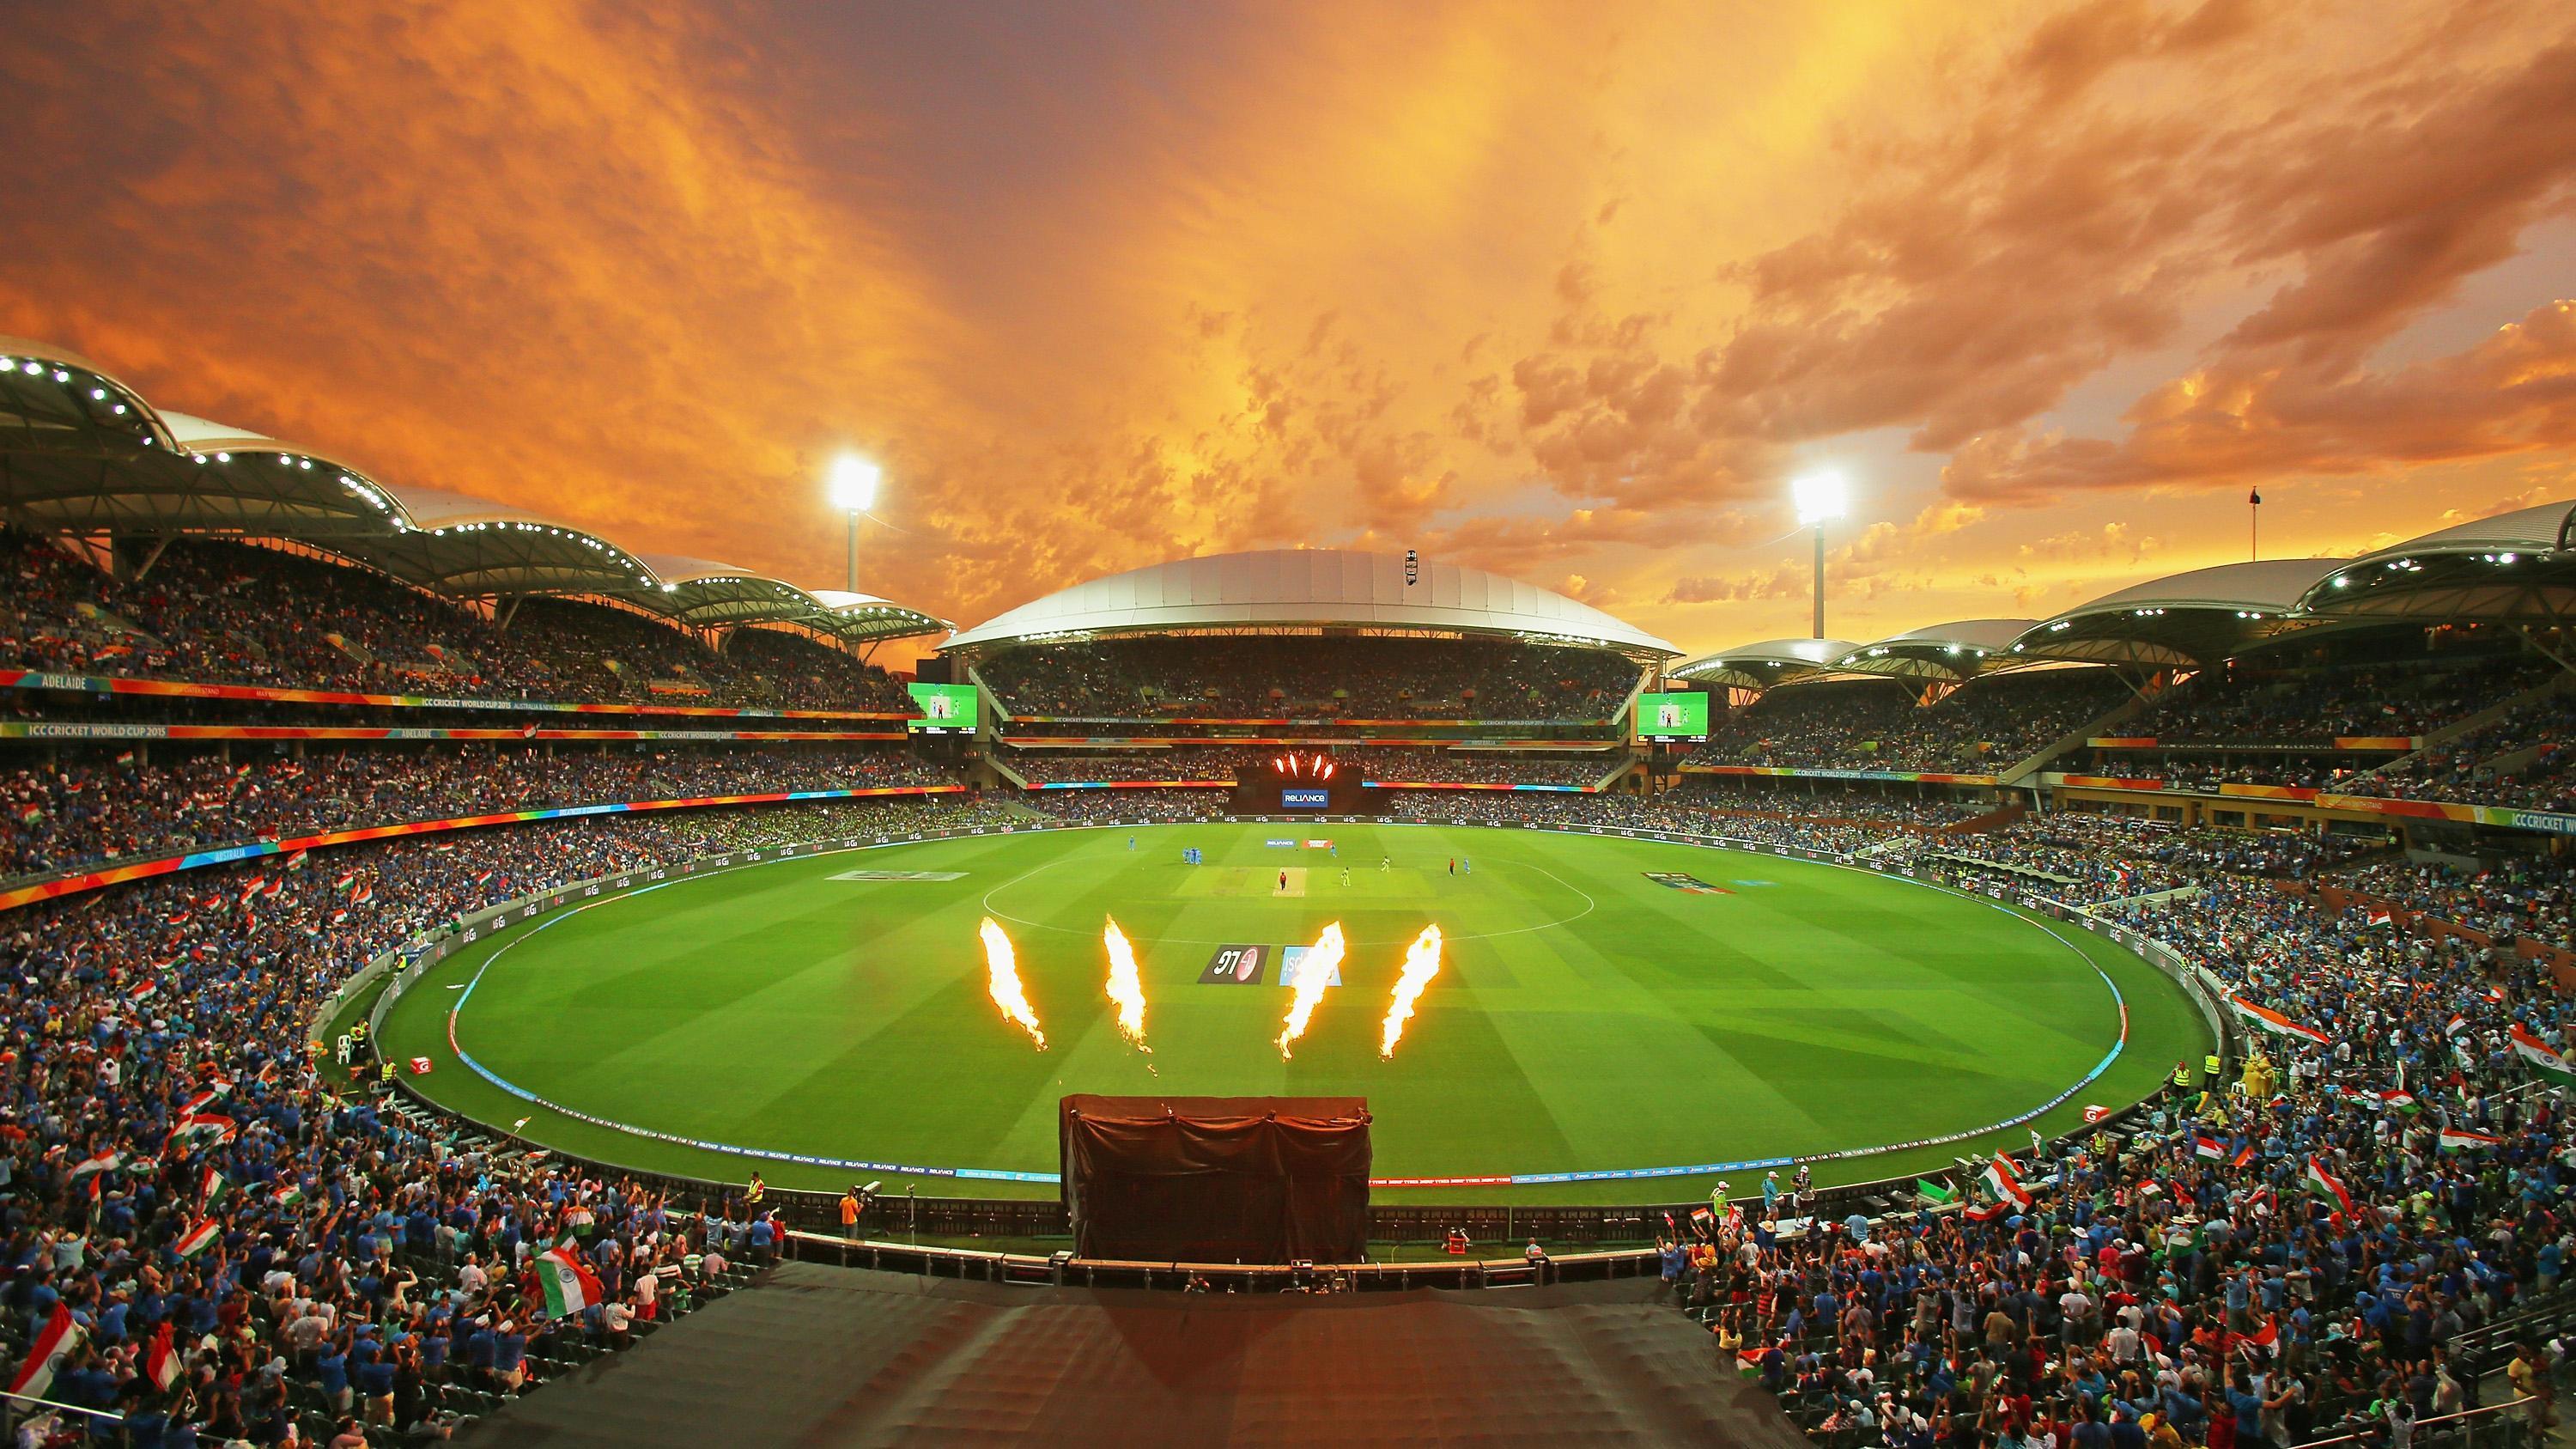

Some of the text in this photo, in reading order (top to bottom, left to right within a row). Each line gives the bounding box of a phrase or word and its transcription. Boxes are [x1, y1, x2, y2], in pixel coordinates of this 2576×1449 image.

[42, 675, 86, 690] ADELAIDE
[433, 698, 460, 707] CRICKET
[498, 701, 511, 709] 2015
[28, 726, 166, 737] ICC CRICKET WORLD CUP 2015
[401, 730, 431, 739] ADELAIDE
[2512, 813, 2526, 827] ICC
[2527, 814, 2563, 831] CRICKET
[525, 907, 529, 916] LG
[493, 919, 498, 928] LG
[2082, 918, 2088, 928] LG
[464, 932, 470, 942] LG
[2110, 928, 2115, 938] LG
